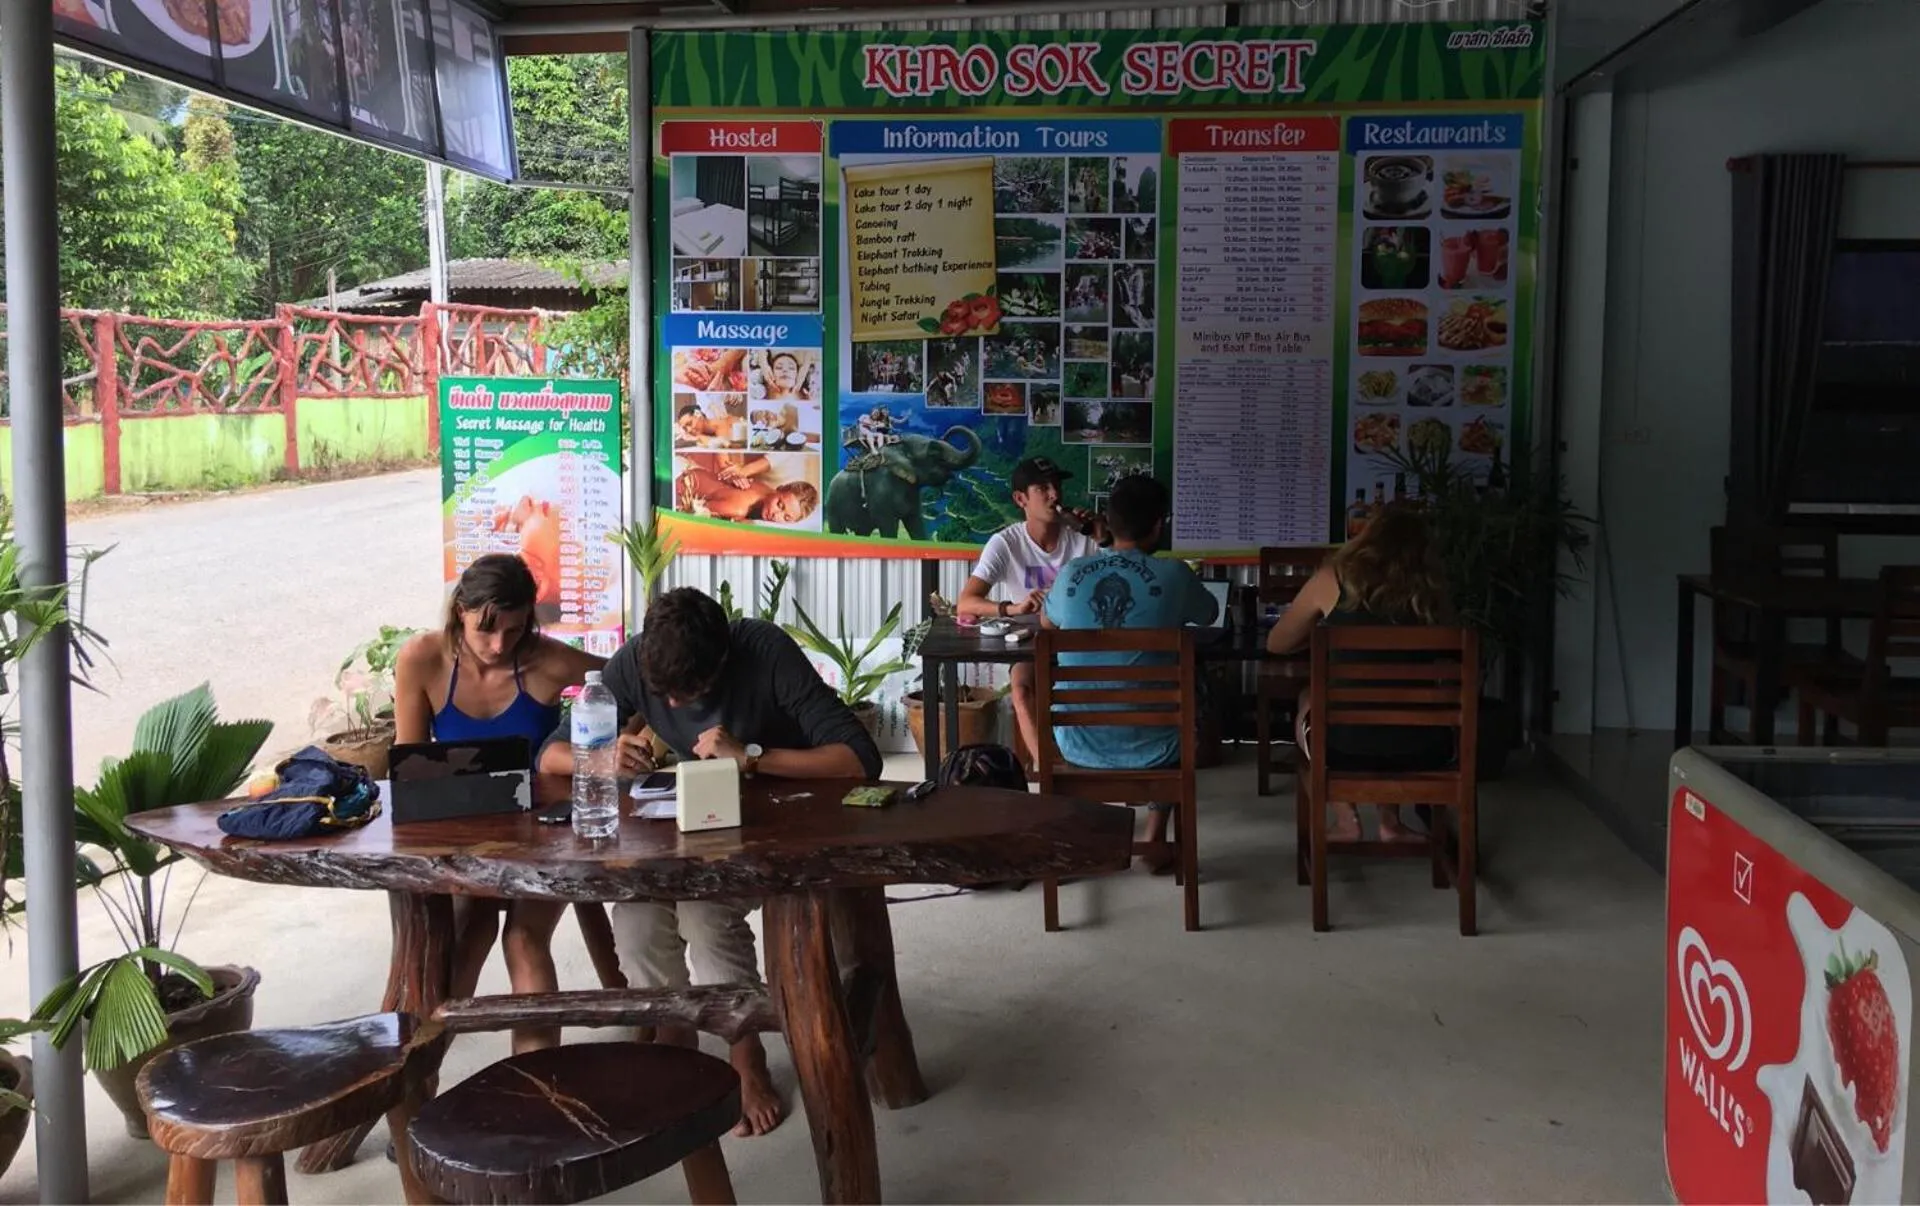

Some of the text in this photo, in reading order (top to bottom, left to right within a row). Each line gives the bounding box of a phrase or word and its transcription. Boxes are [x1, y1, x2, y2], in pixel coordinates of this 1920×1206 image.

[863, 40, 1317, 97] KHAO SOK SECRET
[709, 127, 777, 147] Hostel
[883, 126, 1108, 148] Information Tours
[1205, 124, 1305, 147] Transfer
[1364, 120, 1507, 146] Restaurants
[854, 188, 875, 198] Lake
[880, 186, 899, 196] tour
[914, 184, 932, 196] day
[854, 203, 876, 214] Lake
[880, 202, 900, 212] tour
[904, 200, 913, 211] 2
[915, 199, 933, 212] day
[947, 196, 973, 210] night
[855, 218, 898, 230] Canoeing
[856, 231, 917, 245] Bamboo raft
[857, 249, 897, 262] Elephant
[858, 260, 993, 277] Elephant bathing Experience
[859, 281, 891, 293] Tubing
[860, 295, 936, 309] Jungle Trekking
[861, 310, 920, 325] Night Safari
[698, 320, 788, 345] Massage
[1193, 331, 1311, 342] Minibus VIP Bus Air Bus
[1200, 342, 1302, 353] and Boat Time Table
[456, 416, 605, 434] Secret Massage for Health
[1679, 1037, 1745, 1149] WALL'S
